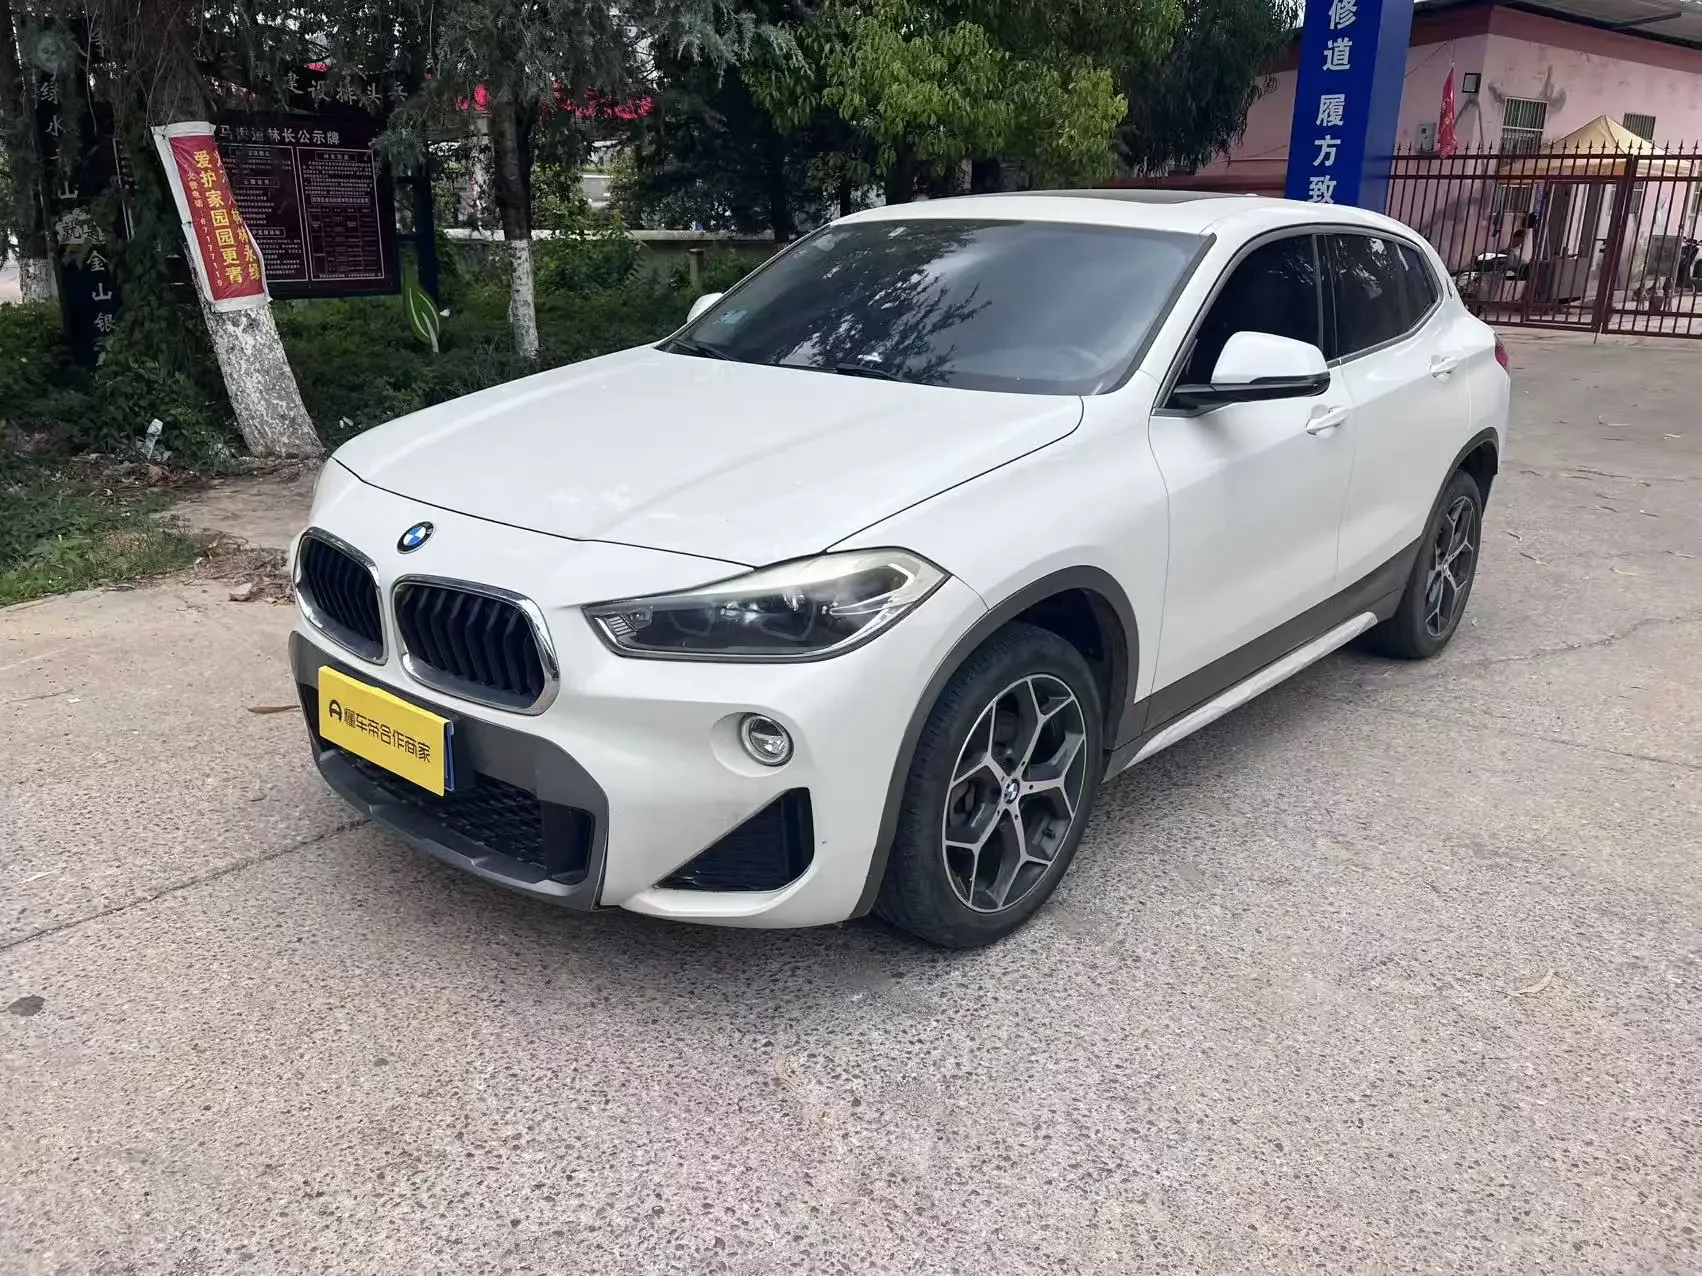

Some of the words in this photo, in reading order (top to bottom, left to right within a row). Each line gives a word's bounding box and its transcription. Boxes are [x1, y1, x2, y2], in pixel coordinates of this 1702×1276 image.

[1323, 0, 1357, 71] 修道
[1307, 93, 1345, 204] 履方致
[194, 150, 243, 283] 爱护家园园更青
[214, 150, 260, 280] 林林永绿
[344, 707, 431, 763] 懂车帝合作商家
